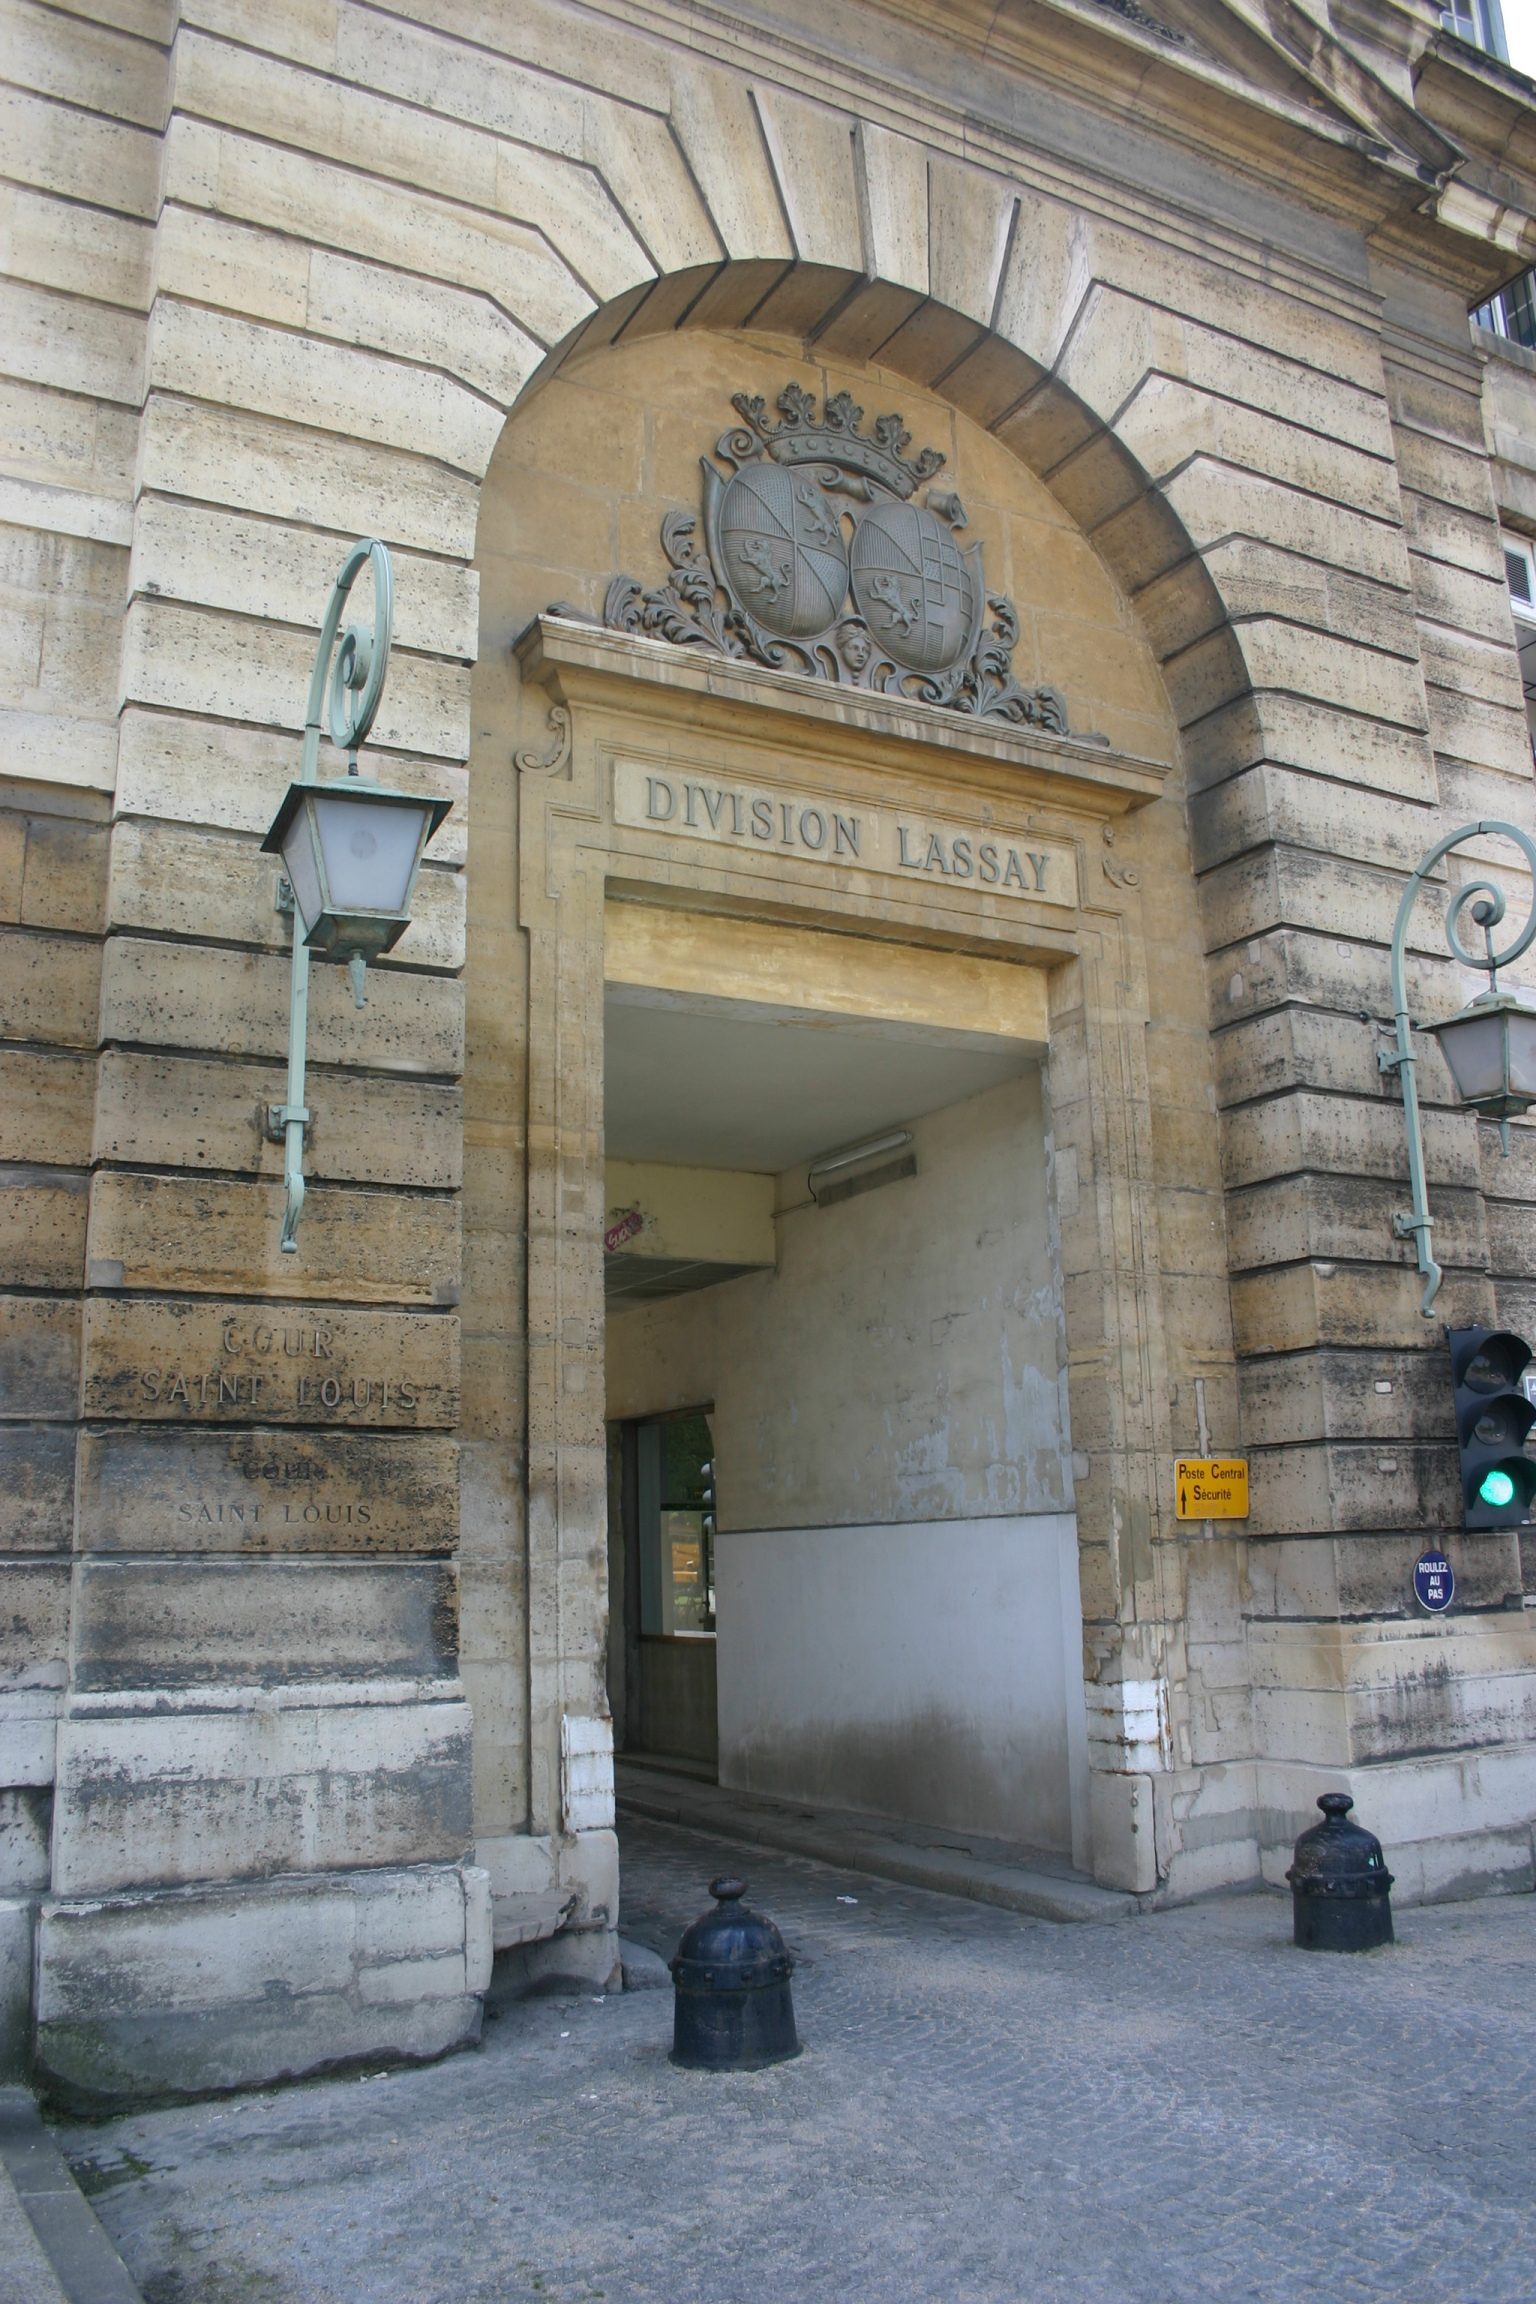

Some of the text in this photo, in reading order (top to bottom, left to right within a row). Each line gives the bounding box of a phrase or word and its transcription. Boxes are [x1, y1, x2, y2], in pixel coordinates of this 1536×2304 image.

[645, 776, 1050, 892] DIVISION LASSAY
[223, 1324, 333, 1358] COUR
[143, 1369, 418, 1408] SAINT LOUIS
[1179, 1464, 1245, 1479] Poste Central
[1193, 1485, 1231, 1500] Sécurité
[178, 1503, 371, 1524] SAINT LOUIS
[1419, 1562, 1448, 1573] ROULEZ
[1430, 1576, 1440, 1586] AU
[1428, 1588, 1443, 1599] PAS
